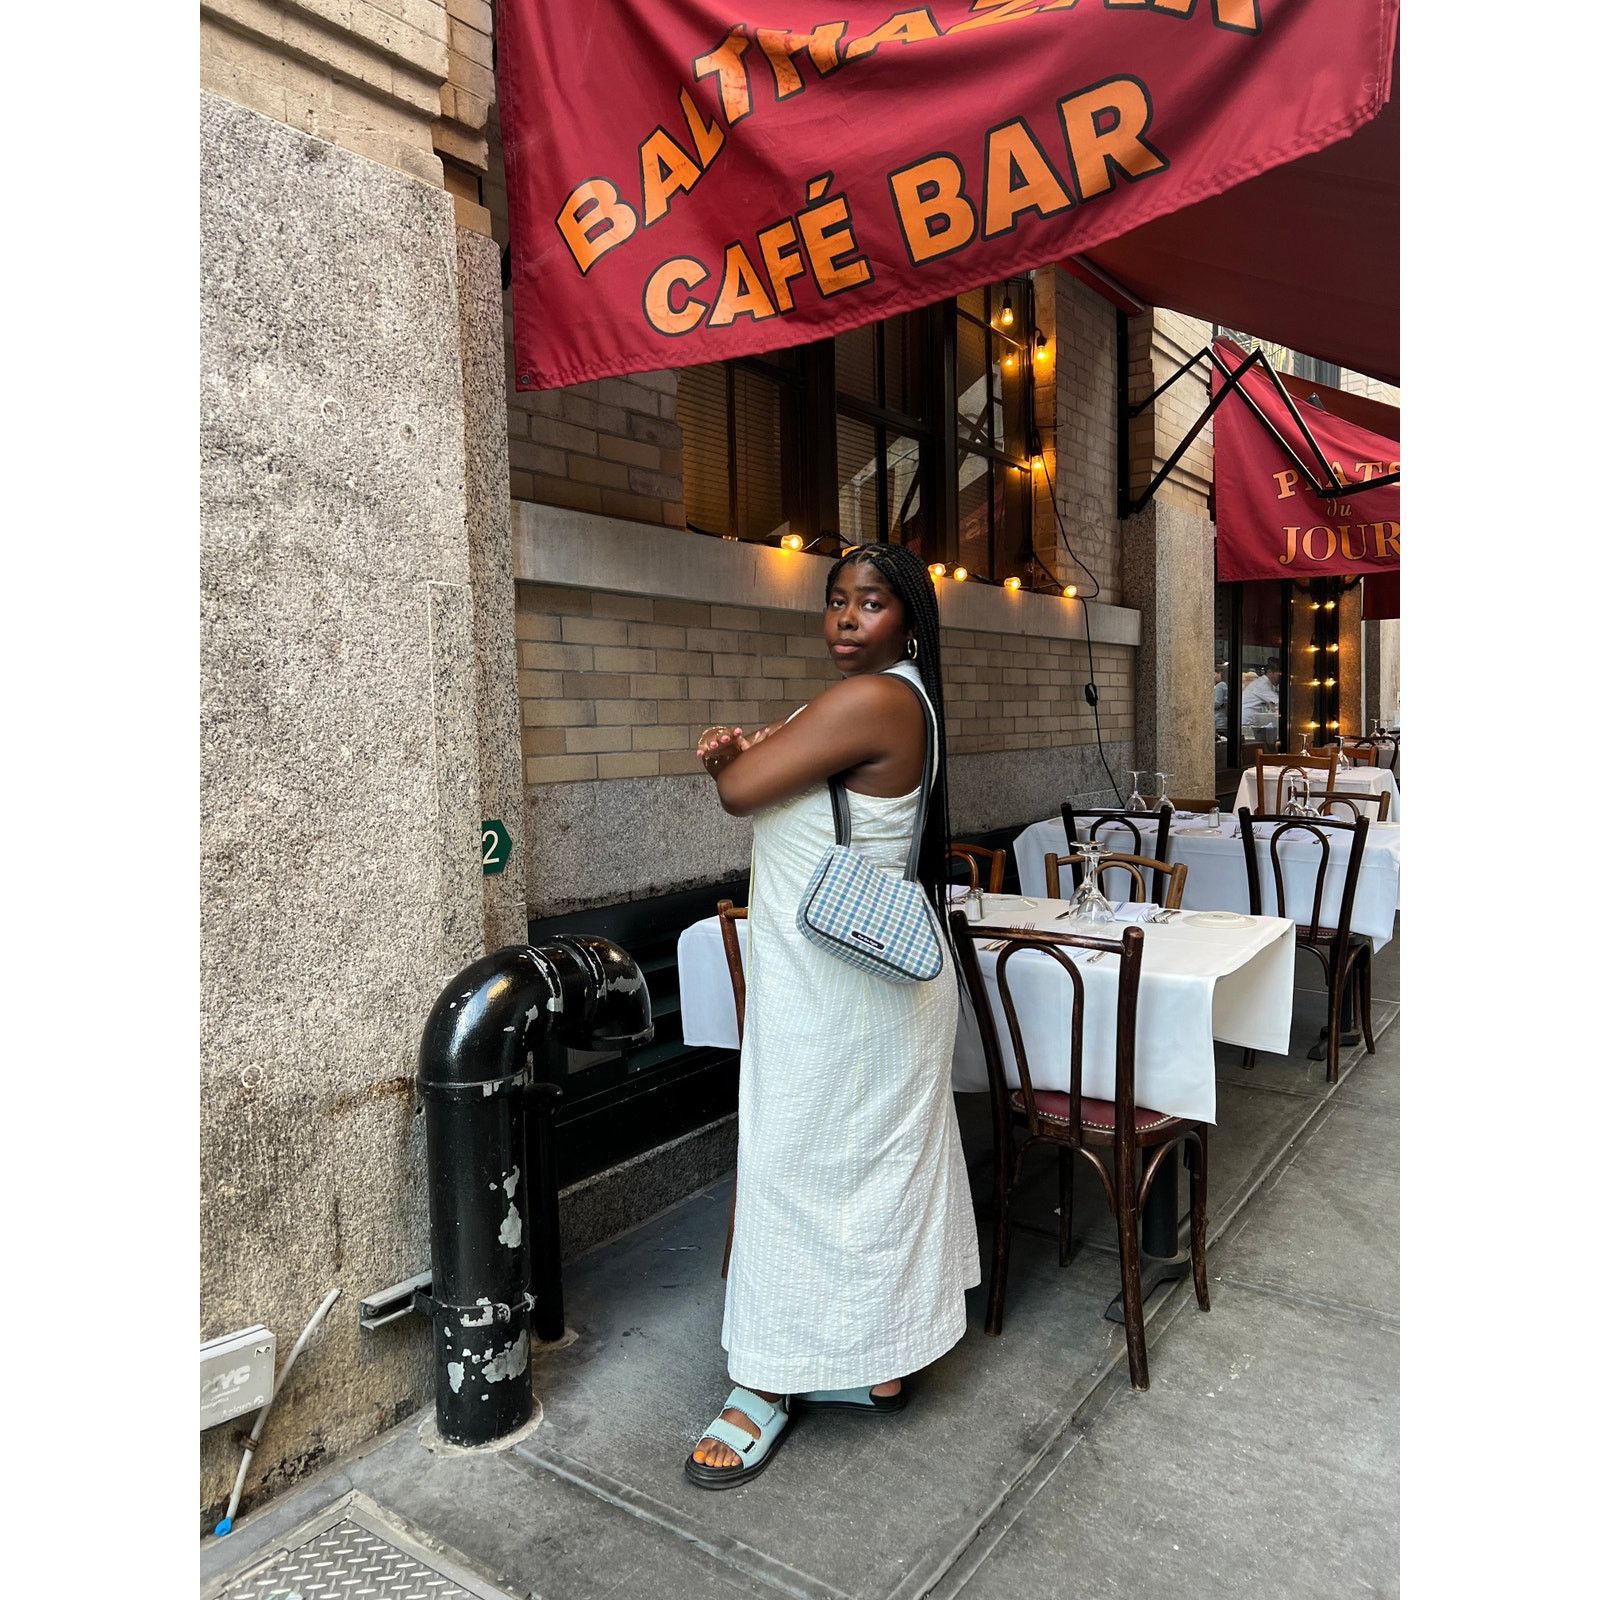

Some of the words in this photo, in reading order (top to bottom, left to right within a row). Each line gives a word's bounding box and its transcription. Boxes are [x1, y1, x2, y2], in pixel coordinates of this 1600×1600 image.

[555, 0, 1263, 275] BALTHAZ
[642, 170, 874, 337] CAFÉ
[887, 74, 1170, 267] BAR
[1272, 460, 1400, 500] PAT
[1278, 521, 1400, 565] JOUR
